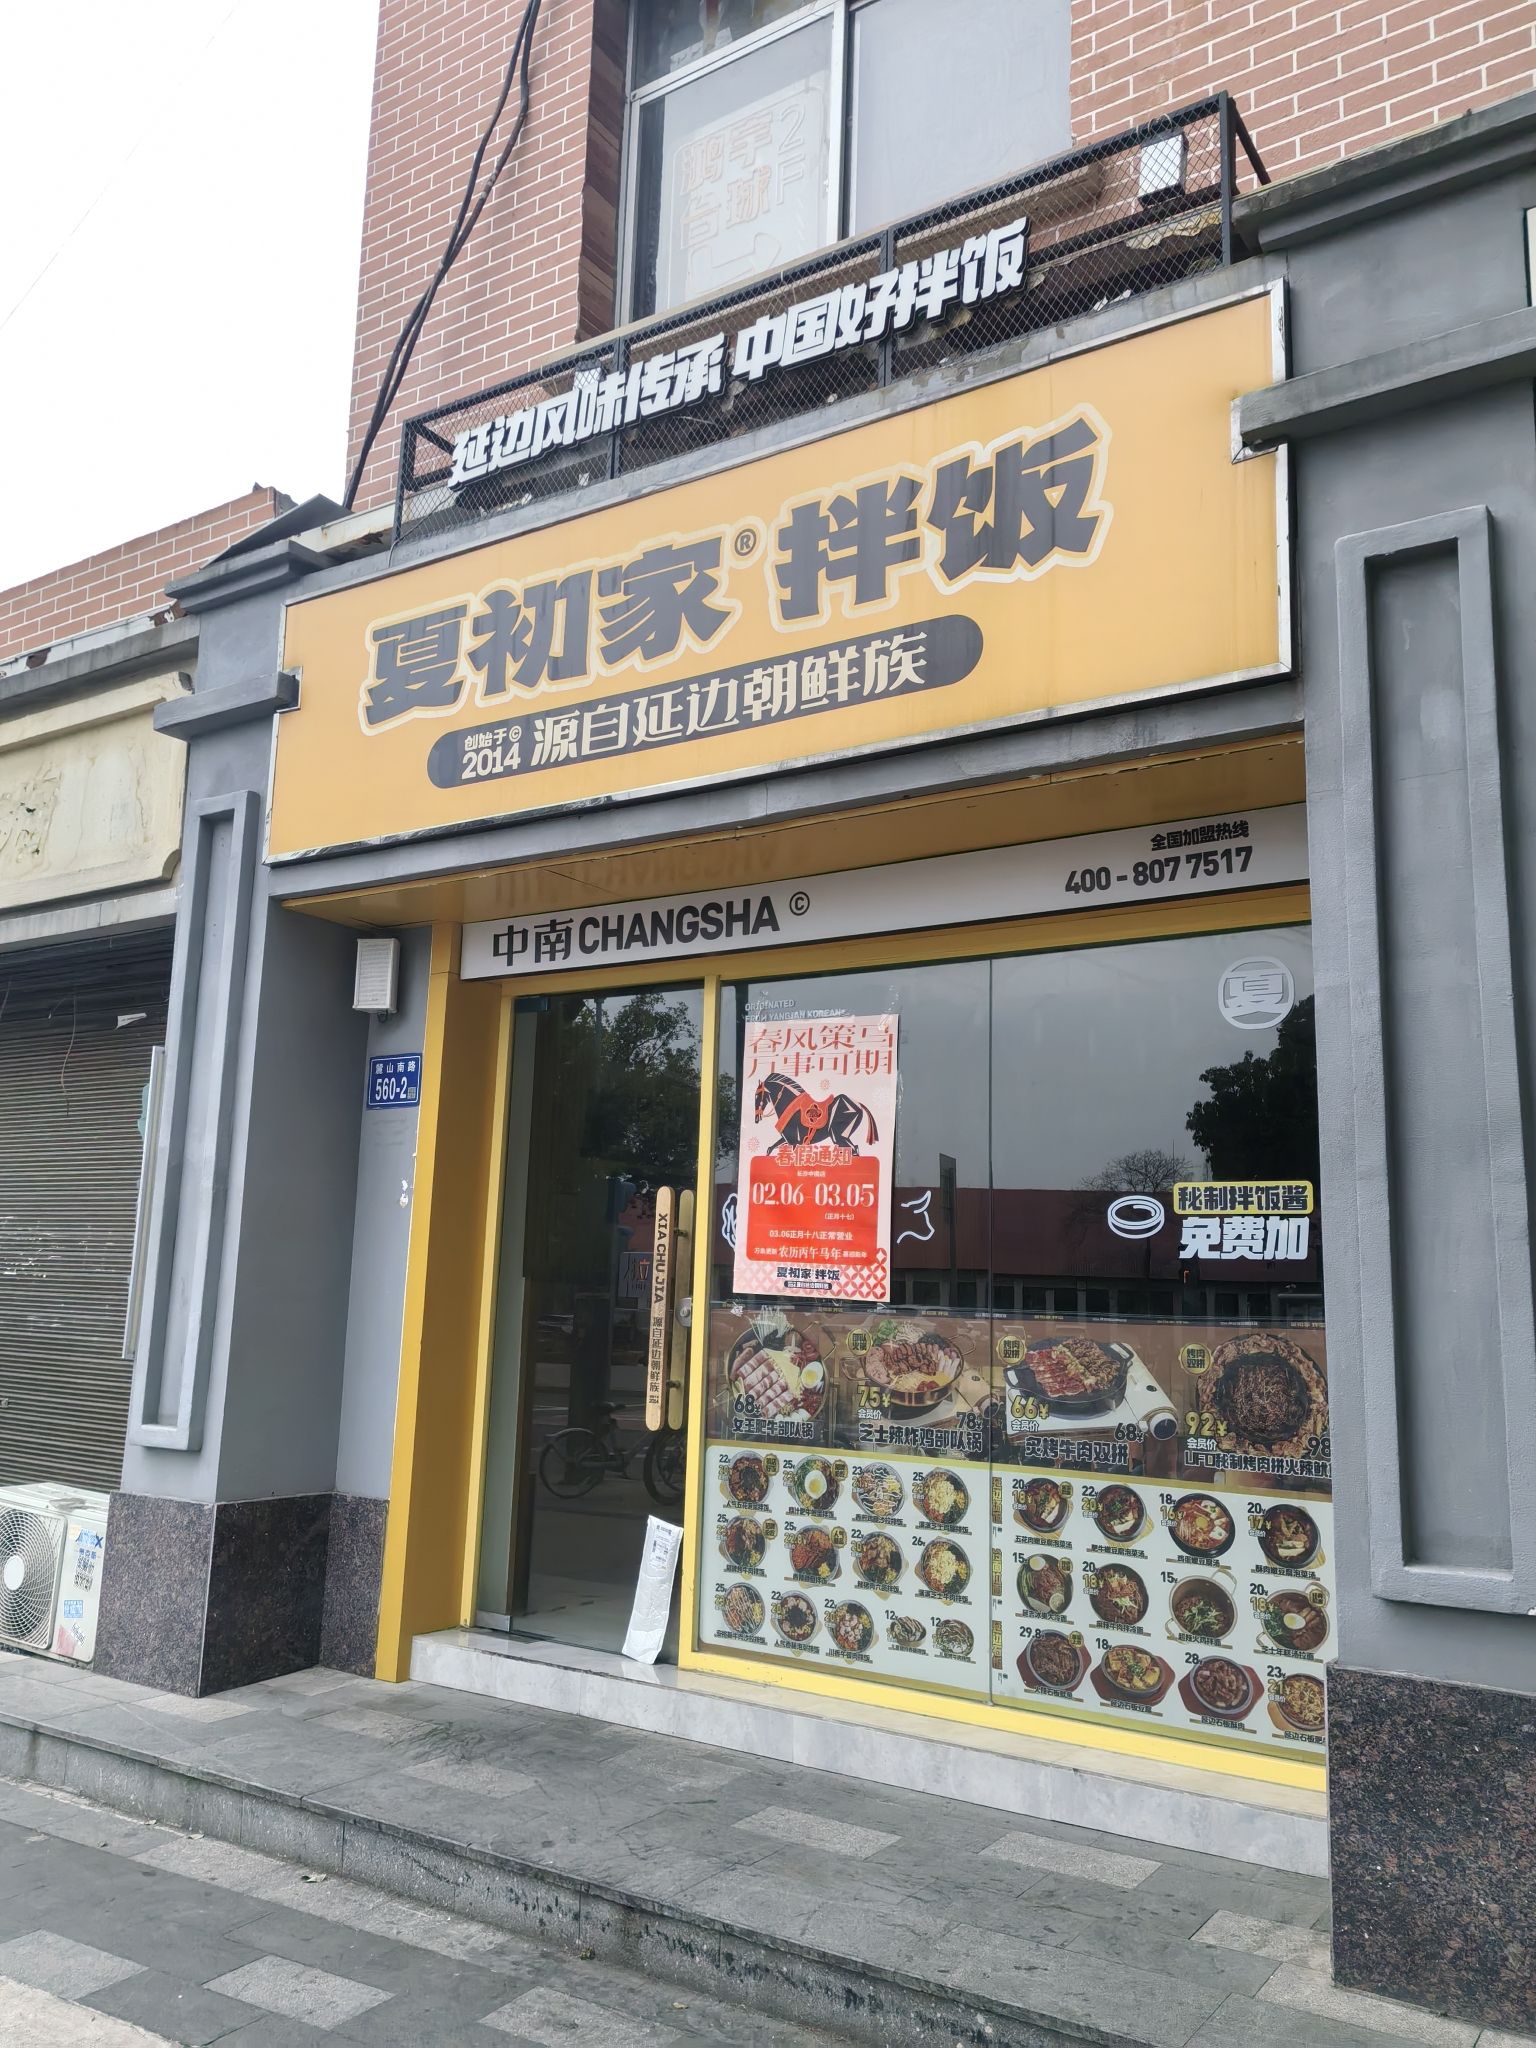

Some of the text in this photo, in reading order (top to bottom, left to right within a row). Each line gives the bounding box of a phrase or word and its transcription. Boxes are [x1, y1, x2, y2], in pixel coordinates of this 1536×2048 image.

[450, 217, 1028, 486] 延边风味传承 中国好拌饭
[774, 416, 1103, 620] 拌饭
[531, 632, 928, 766] 源自延边朝鲜族
[461, 742, 521, 780] 2014
[1151, 820, 1249, 851] 全国加盟热线
[375, 1076, 408, 1101] 560-2
[1177, 1185, 1309, 1212] 秘制拌饭酱
[653, 1213, 669, 1304] XIA CHU JIA
[1179, 1216, 1311, 1260] 免费加
[1184, 1450, 1332, 1479] UFO秘制烤肉拼火辣鱿
